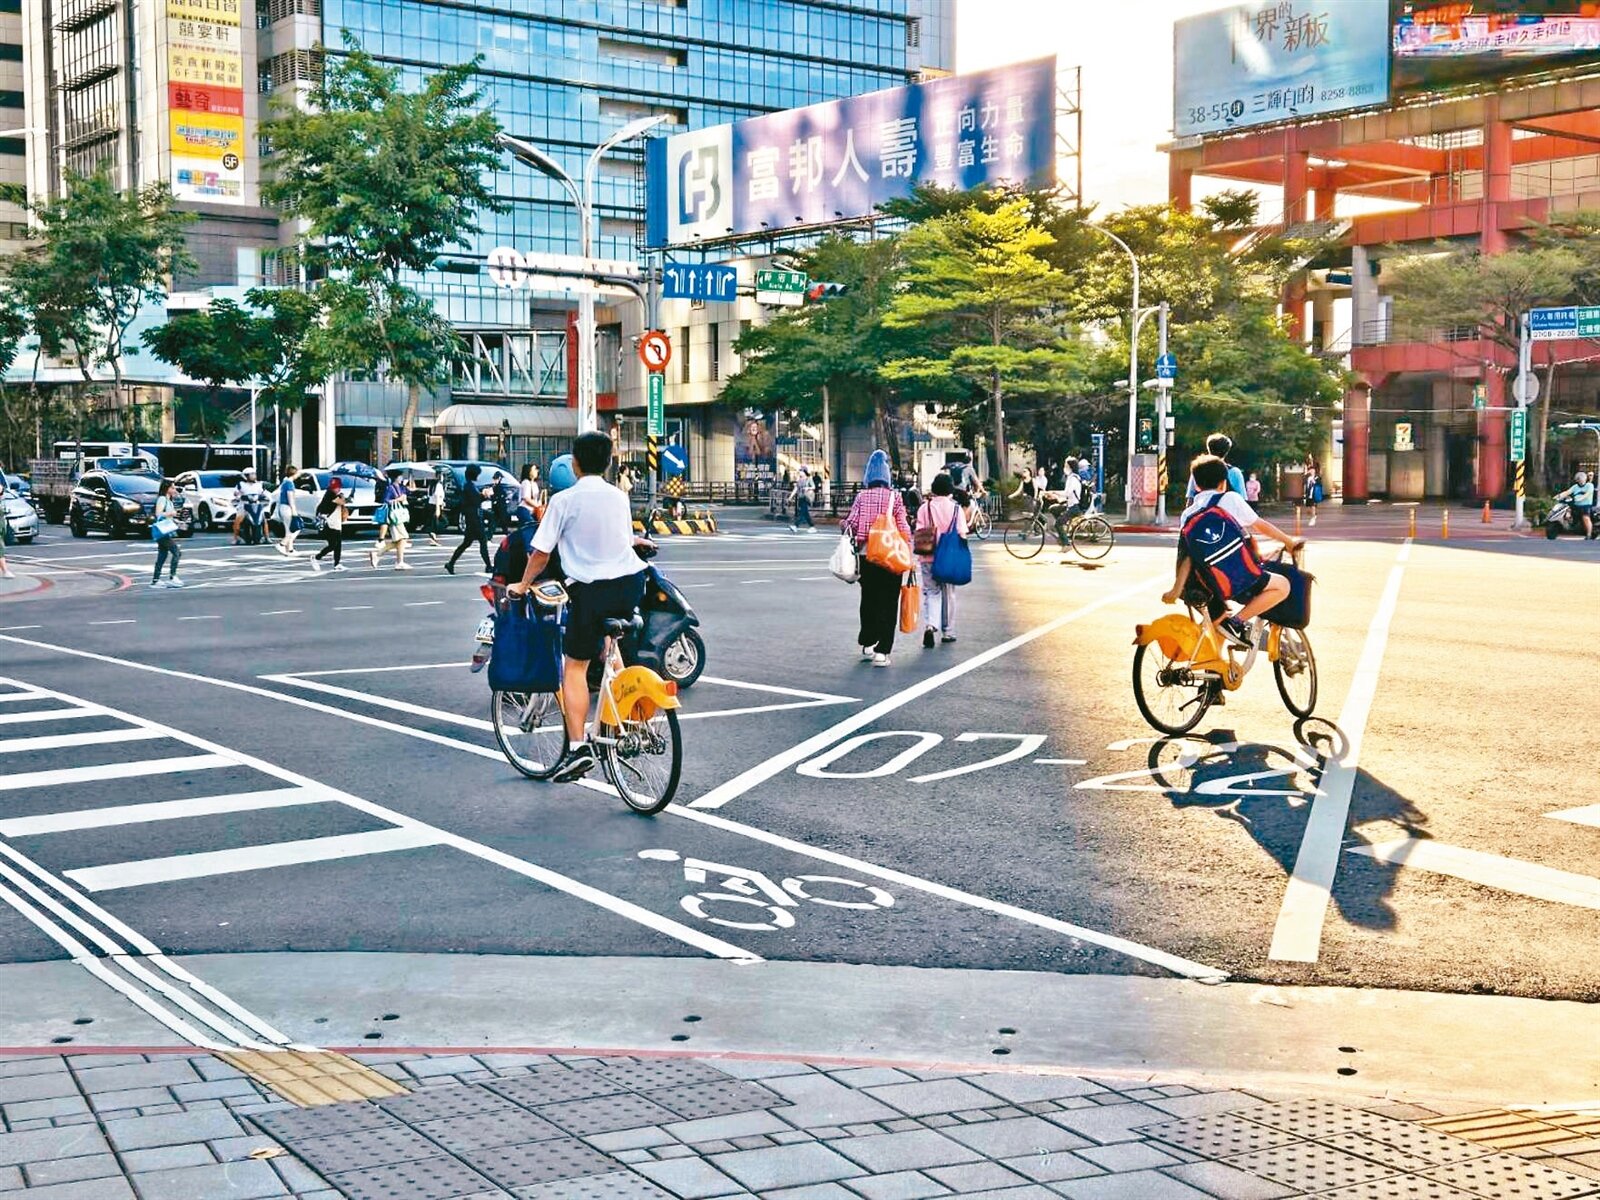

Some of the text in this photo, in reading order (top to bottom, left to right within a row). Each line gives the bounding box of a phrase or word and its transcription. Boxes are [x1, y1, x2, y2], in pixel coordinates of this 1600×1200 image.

[224, 156, 237, 168] 5F
[746, 116, 919, 202] 富邦人壽
[934, 132, 1025, 173] 豐富生命
